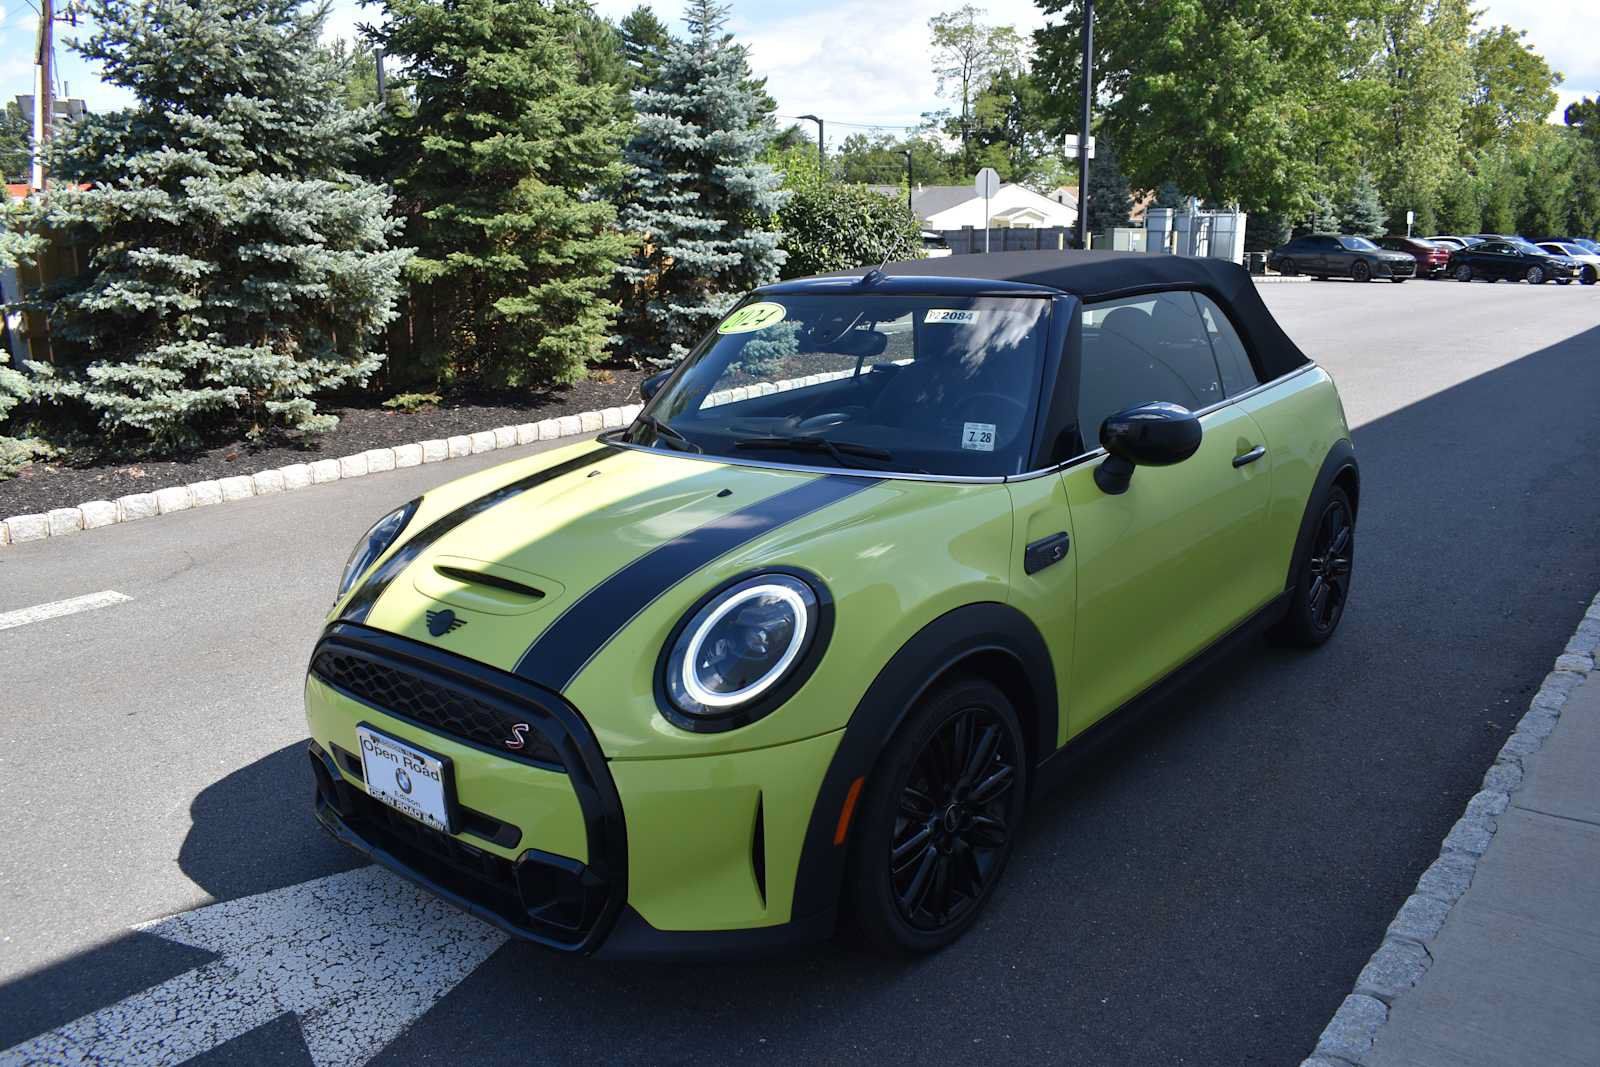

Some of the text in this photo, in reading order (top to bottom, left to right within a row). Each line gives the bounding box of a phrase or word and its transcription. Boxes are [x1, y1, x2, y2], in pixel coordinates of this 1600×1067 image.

[969, 431, 992, 443] 7 28
[505, 723, 529, 749] S
[363, 739, 440, 782] Open Road
